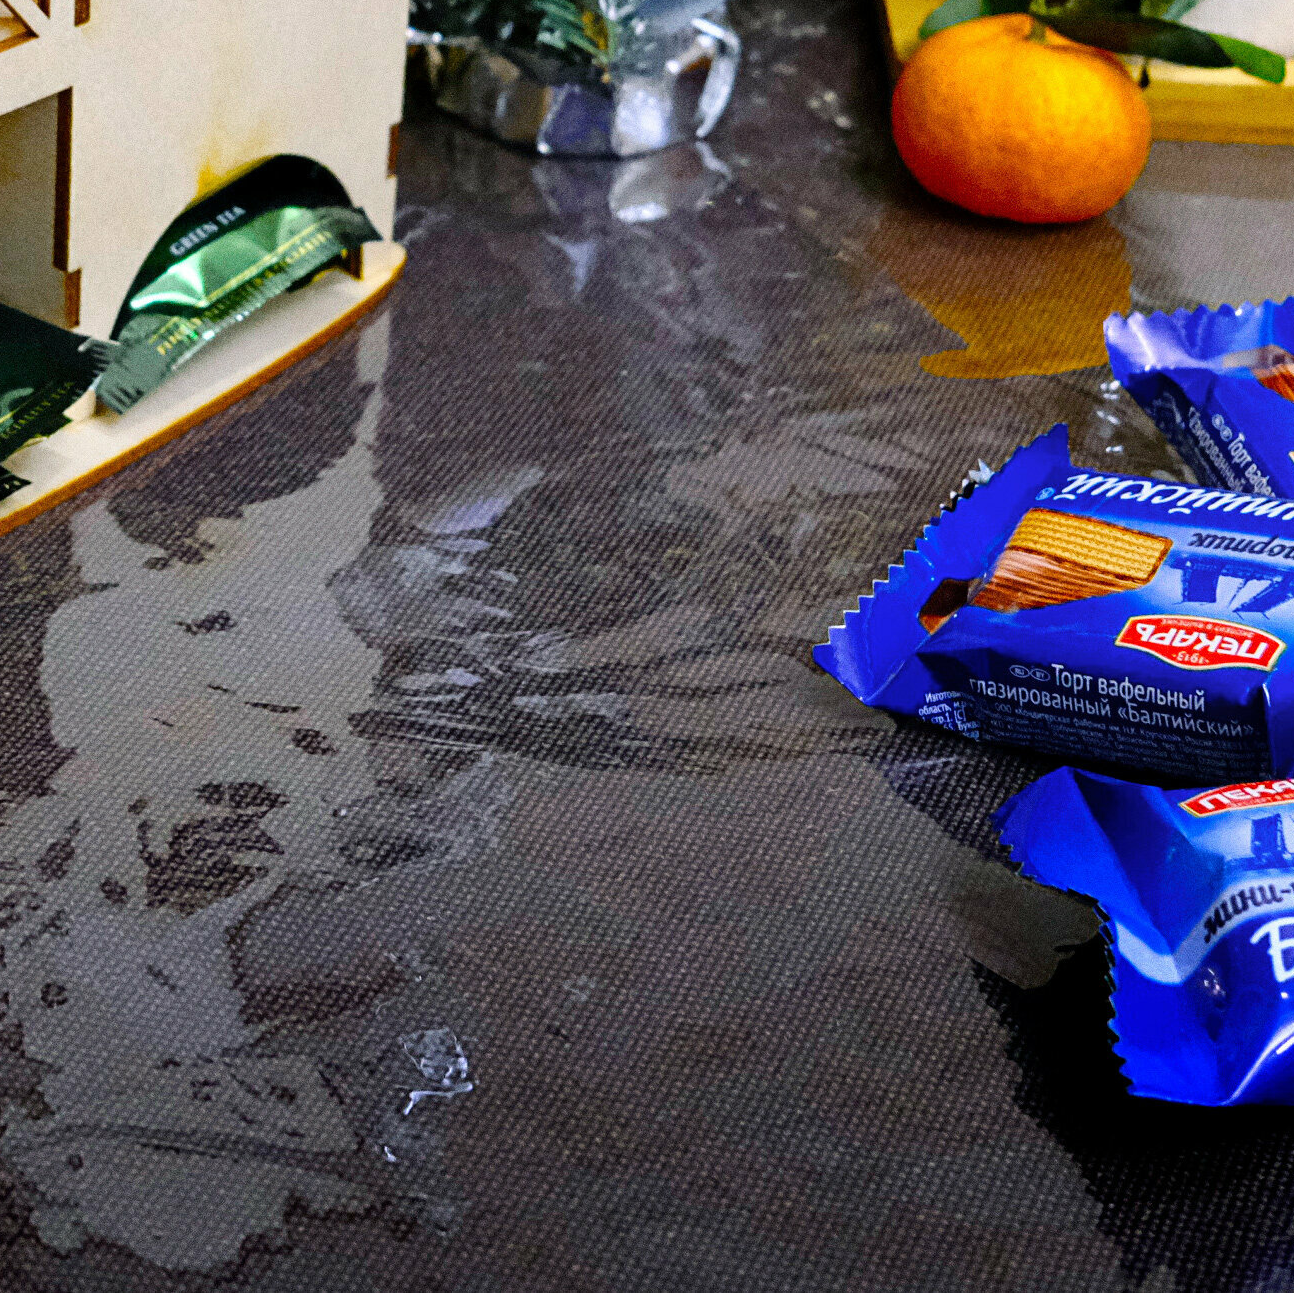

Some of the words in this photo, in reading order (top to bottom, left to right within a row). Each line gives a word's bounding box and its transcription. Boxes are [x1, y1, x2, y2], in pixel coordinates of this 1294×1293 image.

[169, 220, 219, 258] GREEN
[1135, 622, 1269, 660] ПЕКАРЬ
[969, 678, 1112, 716] глазированный
[1051, 663, 1094, 698] Торт
[1097, 676, 1205, 713] вафельный
